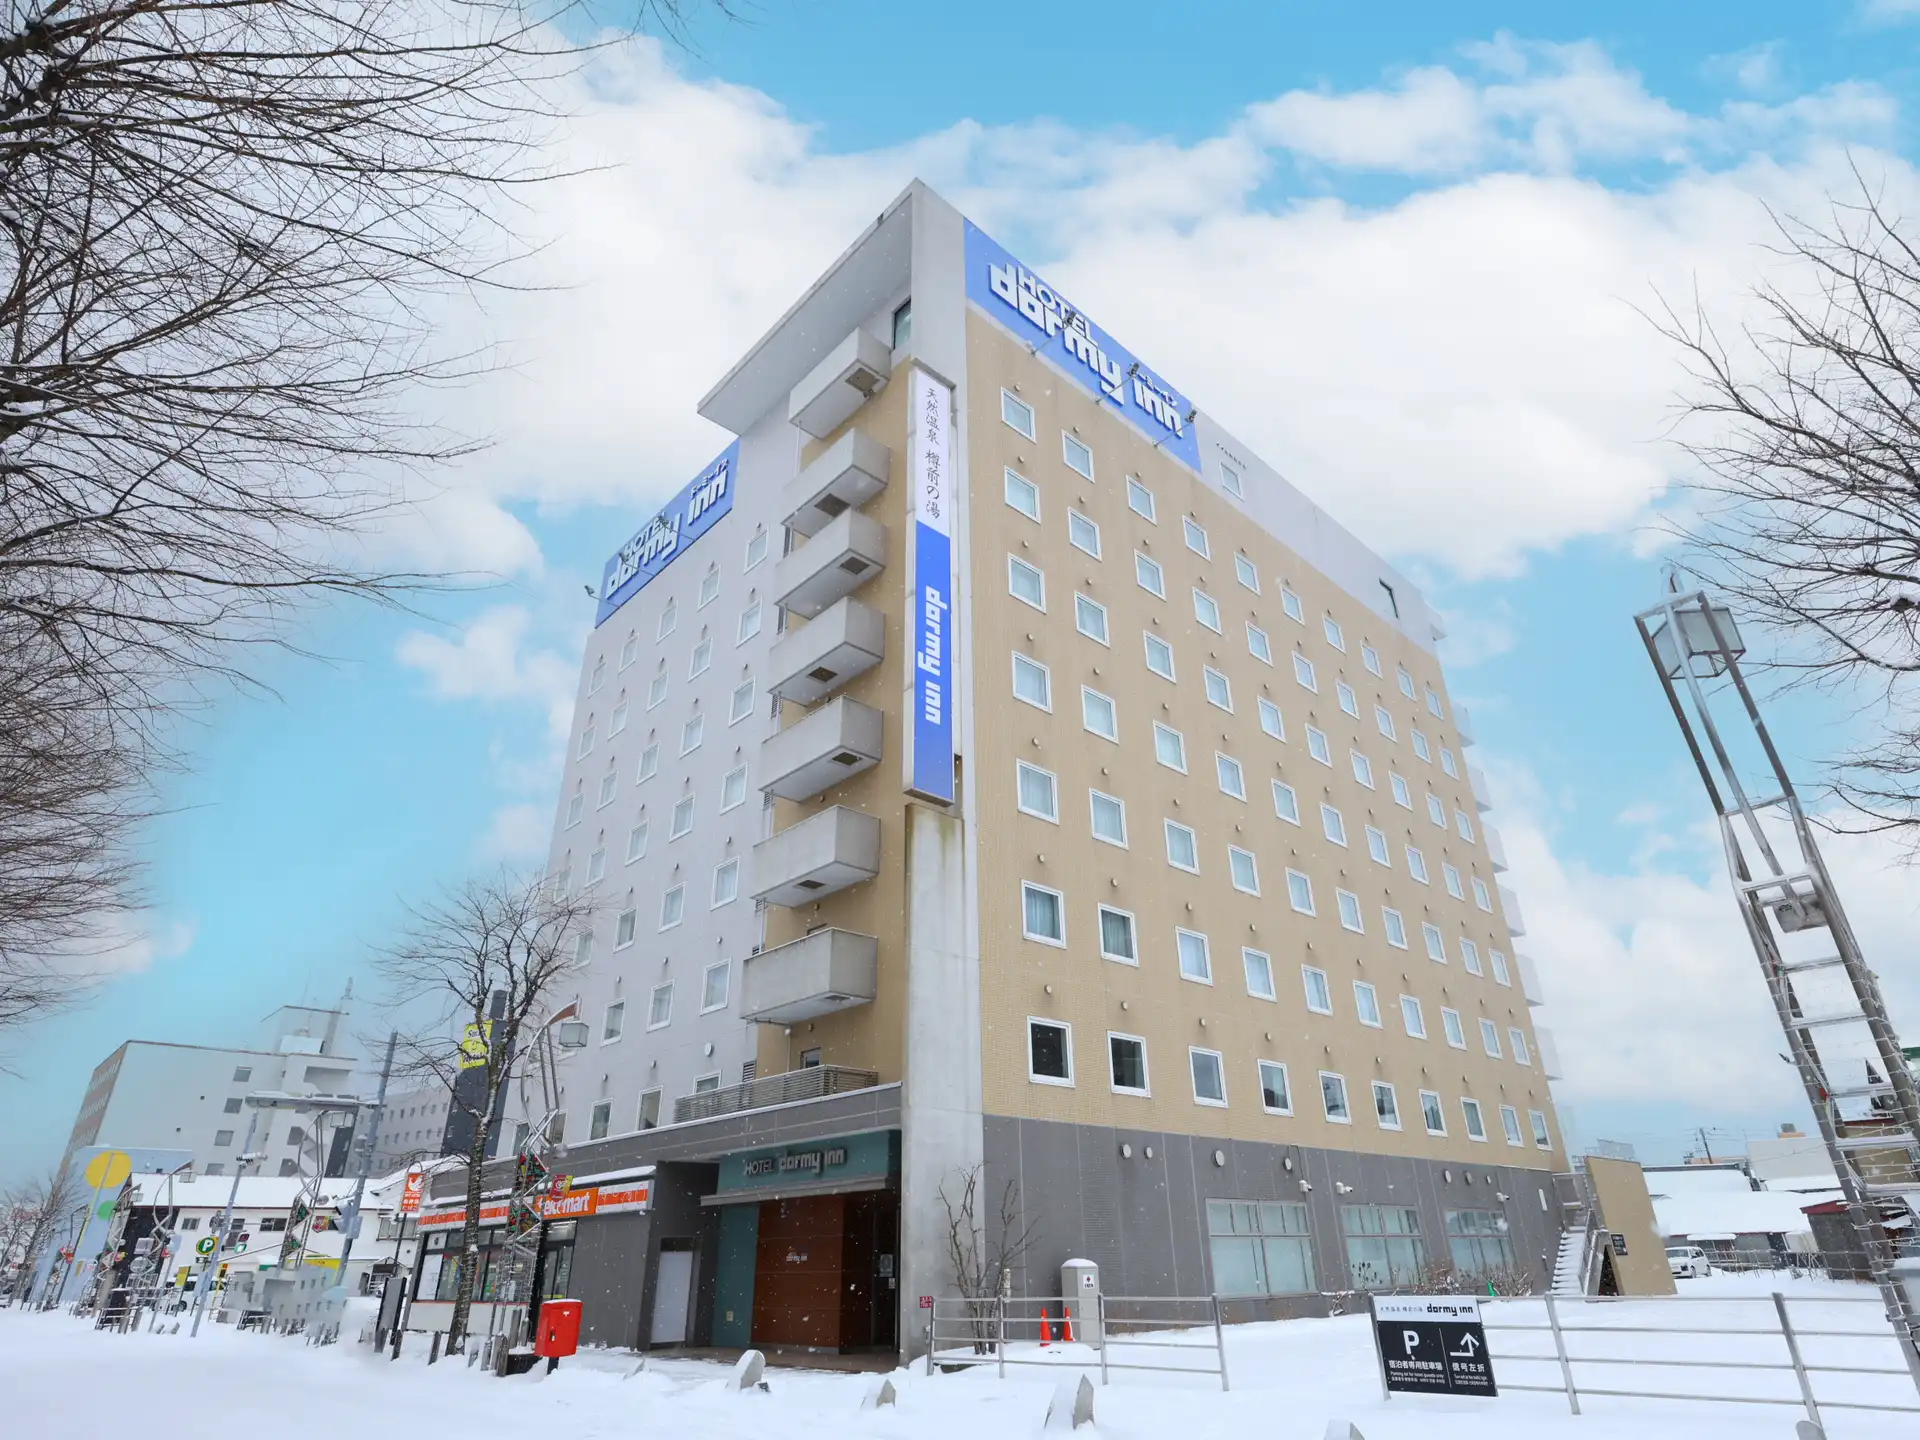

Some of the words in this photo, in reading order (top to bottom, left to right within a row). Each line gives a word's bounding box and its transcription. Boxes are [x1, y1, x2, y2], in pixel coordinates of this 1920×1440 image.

[1017, 264, 1098, 347] HOTEL
[988, 262, 1124, 406] dormy
[1132, 377, 1184, 439] inn
[925, 388, 940, 446] 天然温泉
[605, 513, 682, 600] dormy
[687, 470, 728, 526] inn
[918, 585, 948, 676] dormy
[925, 680, 940, 725] inn
[744, 1159, 774, 1175] HOTEL
[780, 1151, 821, 1174] dormy
[824, 1148, 844, 1165] inn
[201, 1239, 215, 1252] P
[1426, 1303, 1458, 1317] dormy
[1459, 1306, 1474, 1314] inn
[1402, 1330, 1420, 1355] P
[1452, 1361, 1485, 1373] 信号左折
